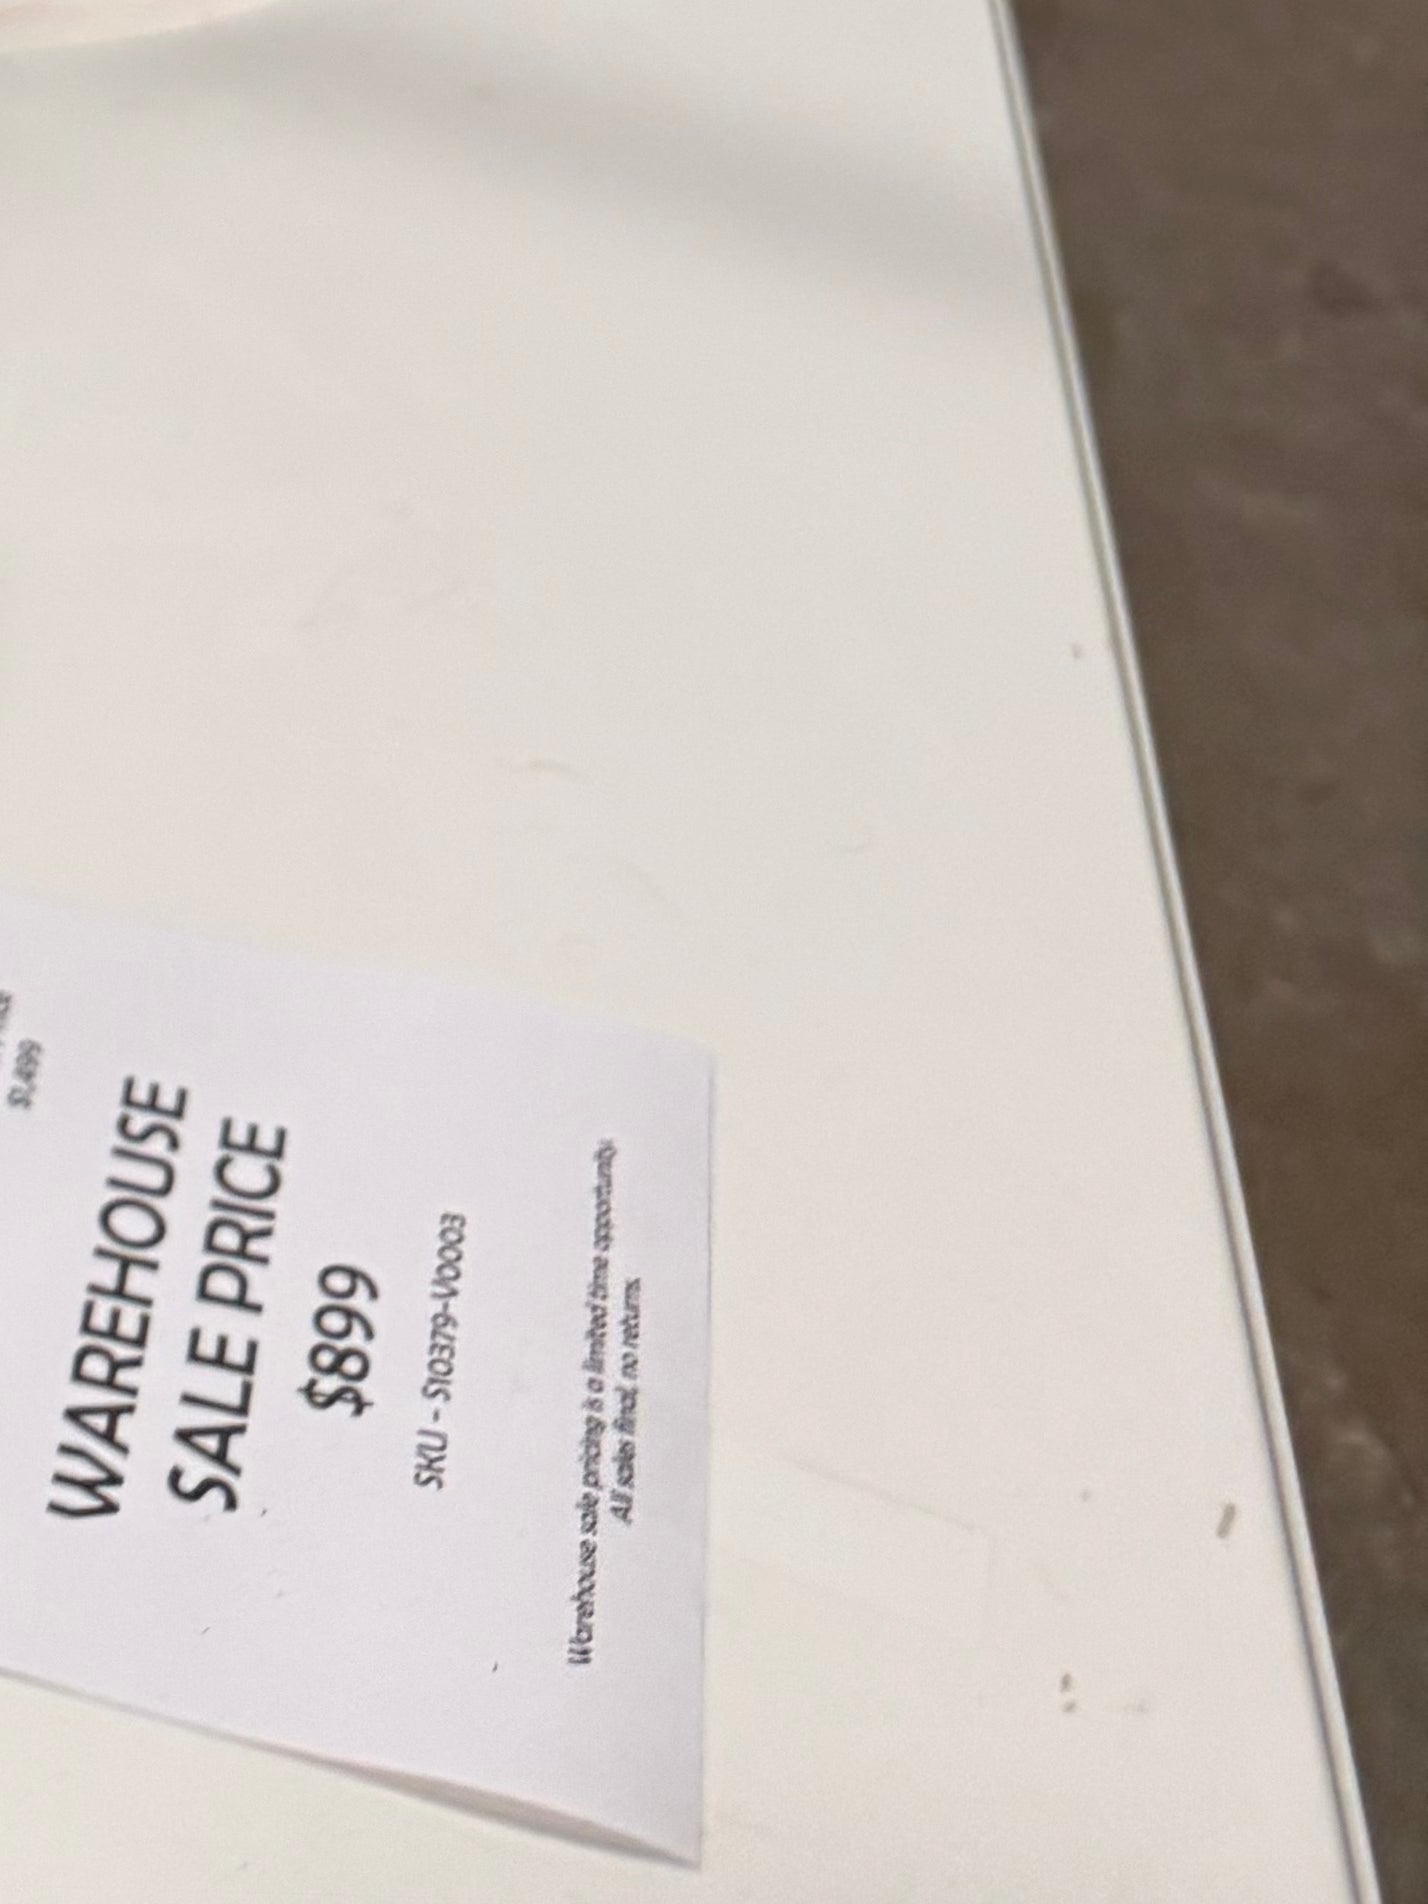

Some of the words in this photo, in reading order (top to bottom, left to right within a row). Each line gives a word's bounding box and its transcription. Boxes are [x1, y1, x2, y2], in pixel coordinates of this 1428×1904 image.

[195, 1117, 288, 1316] PRICE
[45, 1075, 189, 1518] WAREHOUSE
[421, 1212, 467, 1401] S10379-V0003
[586, 1255, 609, 1300] time
[297, 1263, 380, 1419] $899
[582, 1302, 607, 1375] limited
[621, 1351, 639, 1380] no
[582, 1396, 603, 1413] is
[587, 1376, 604, 1394] a
[168, 1325, 259, 1513] SALE
[414, 1429, 448, 1491] SKU
[578, 1415, 607, 1491] pricing
[611, 1439, 635, 1489] sales
[575, 1492, 599, 1536] sale
[610, 1489, 634, 1524] All
[567, 1539, 597, 1665] Warehouse
